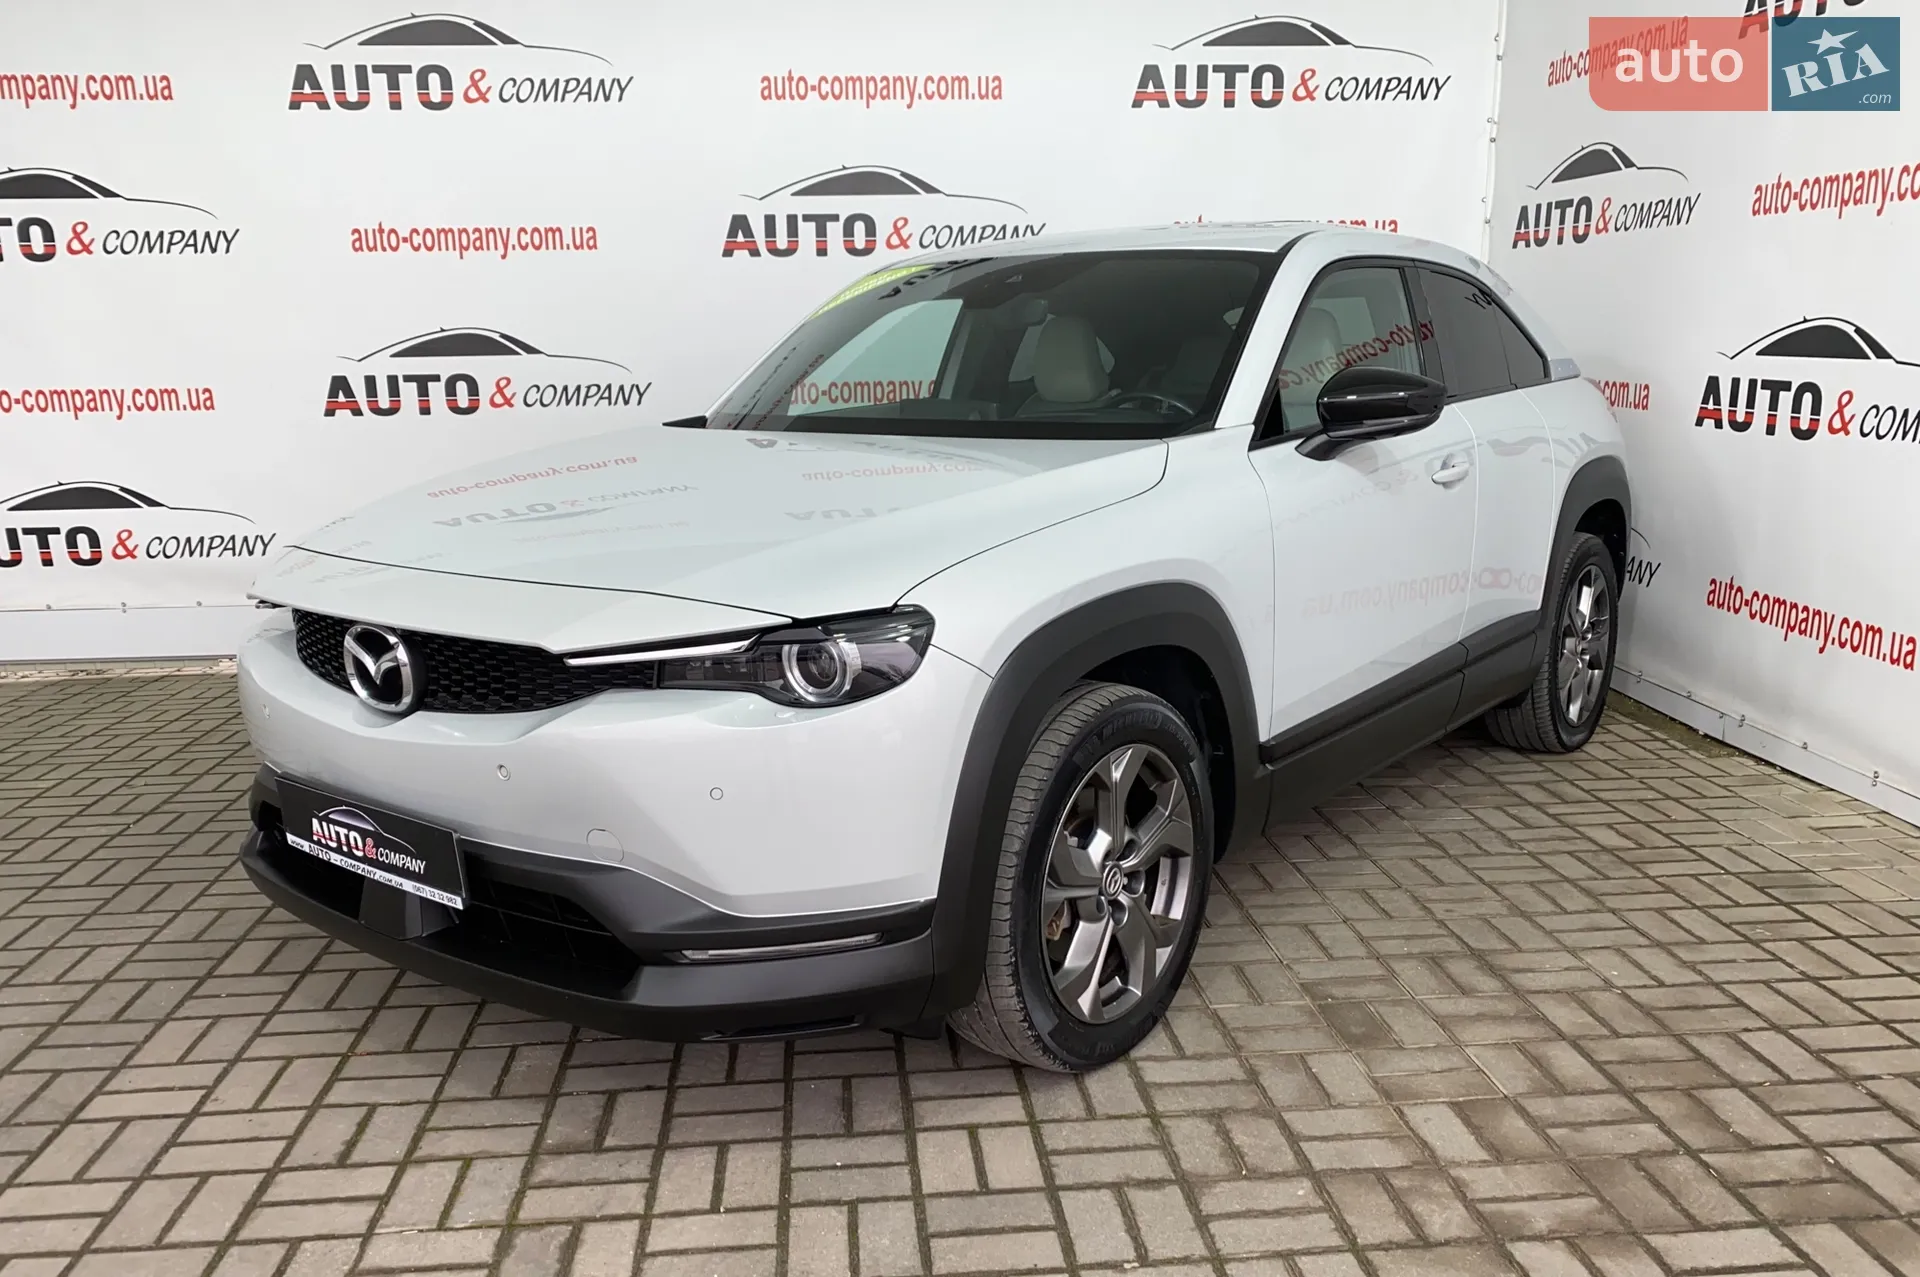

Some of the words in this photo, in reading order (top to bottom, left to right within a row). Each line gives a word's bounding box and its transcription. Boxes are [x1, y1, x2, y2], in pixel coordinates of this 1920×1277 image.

[1547, 15, 1689, 87] auto-companycom.ua
[288, 64, 454, 111] AUTO
[463, 69, 492, 104] &
[499, 76, 634, 103] COMPANY
[760, 69, 1003, 109] auto-company.com.ua
[1131, 64, 1285, 108] AUTO
[1292, 68, 1319, 102] &
[1325, 75, 1451, 102] COMPANY
[66, 221, 95, 255] &
[102, 228, 240, 255] COMPANY
[350, 221, 599, 260] auto-company.com.ua
[722, 213, 877, 257] AUTO
[885, 217, 914, 250] &
[1512, 195, 1593, 249] AUTO
[1595, 197, 1612, 235] &
[1614, 193, 1701, 232] COMPANY
[323, 373, 480, 417] AUTO
[489, 377, 517, 408] &
[523, 382, 652, 408] COMPANY
[1694, 375, 1823, 441] AUTO
[1828, 390, 1857, 436] &
[111, 529, 140, 560] &
[146, 533, 276, 560] COMPANY
[1706, 575, 1917, 671] auto-company.com.ua
[311, 817, 364, 857] AUTO
[365, 837, 377, 859] &
[377, 847, 427, 874] COMPANY
